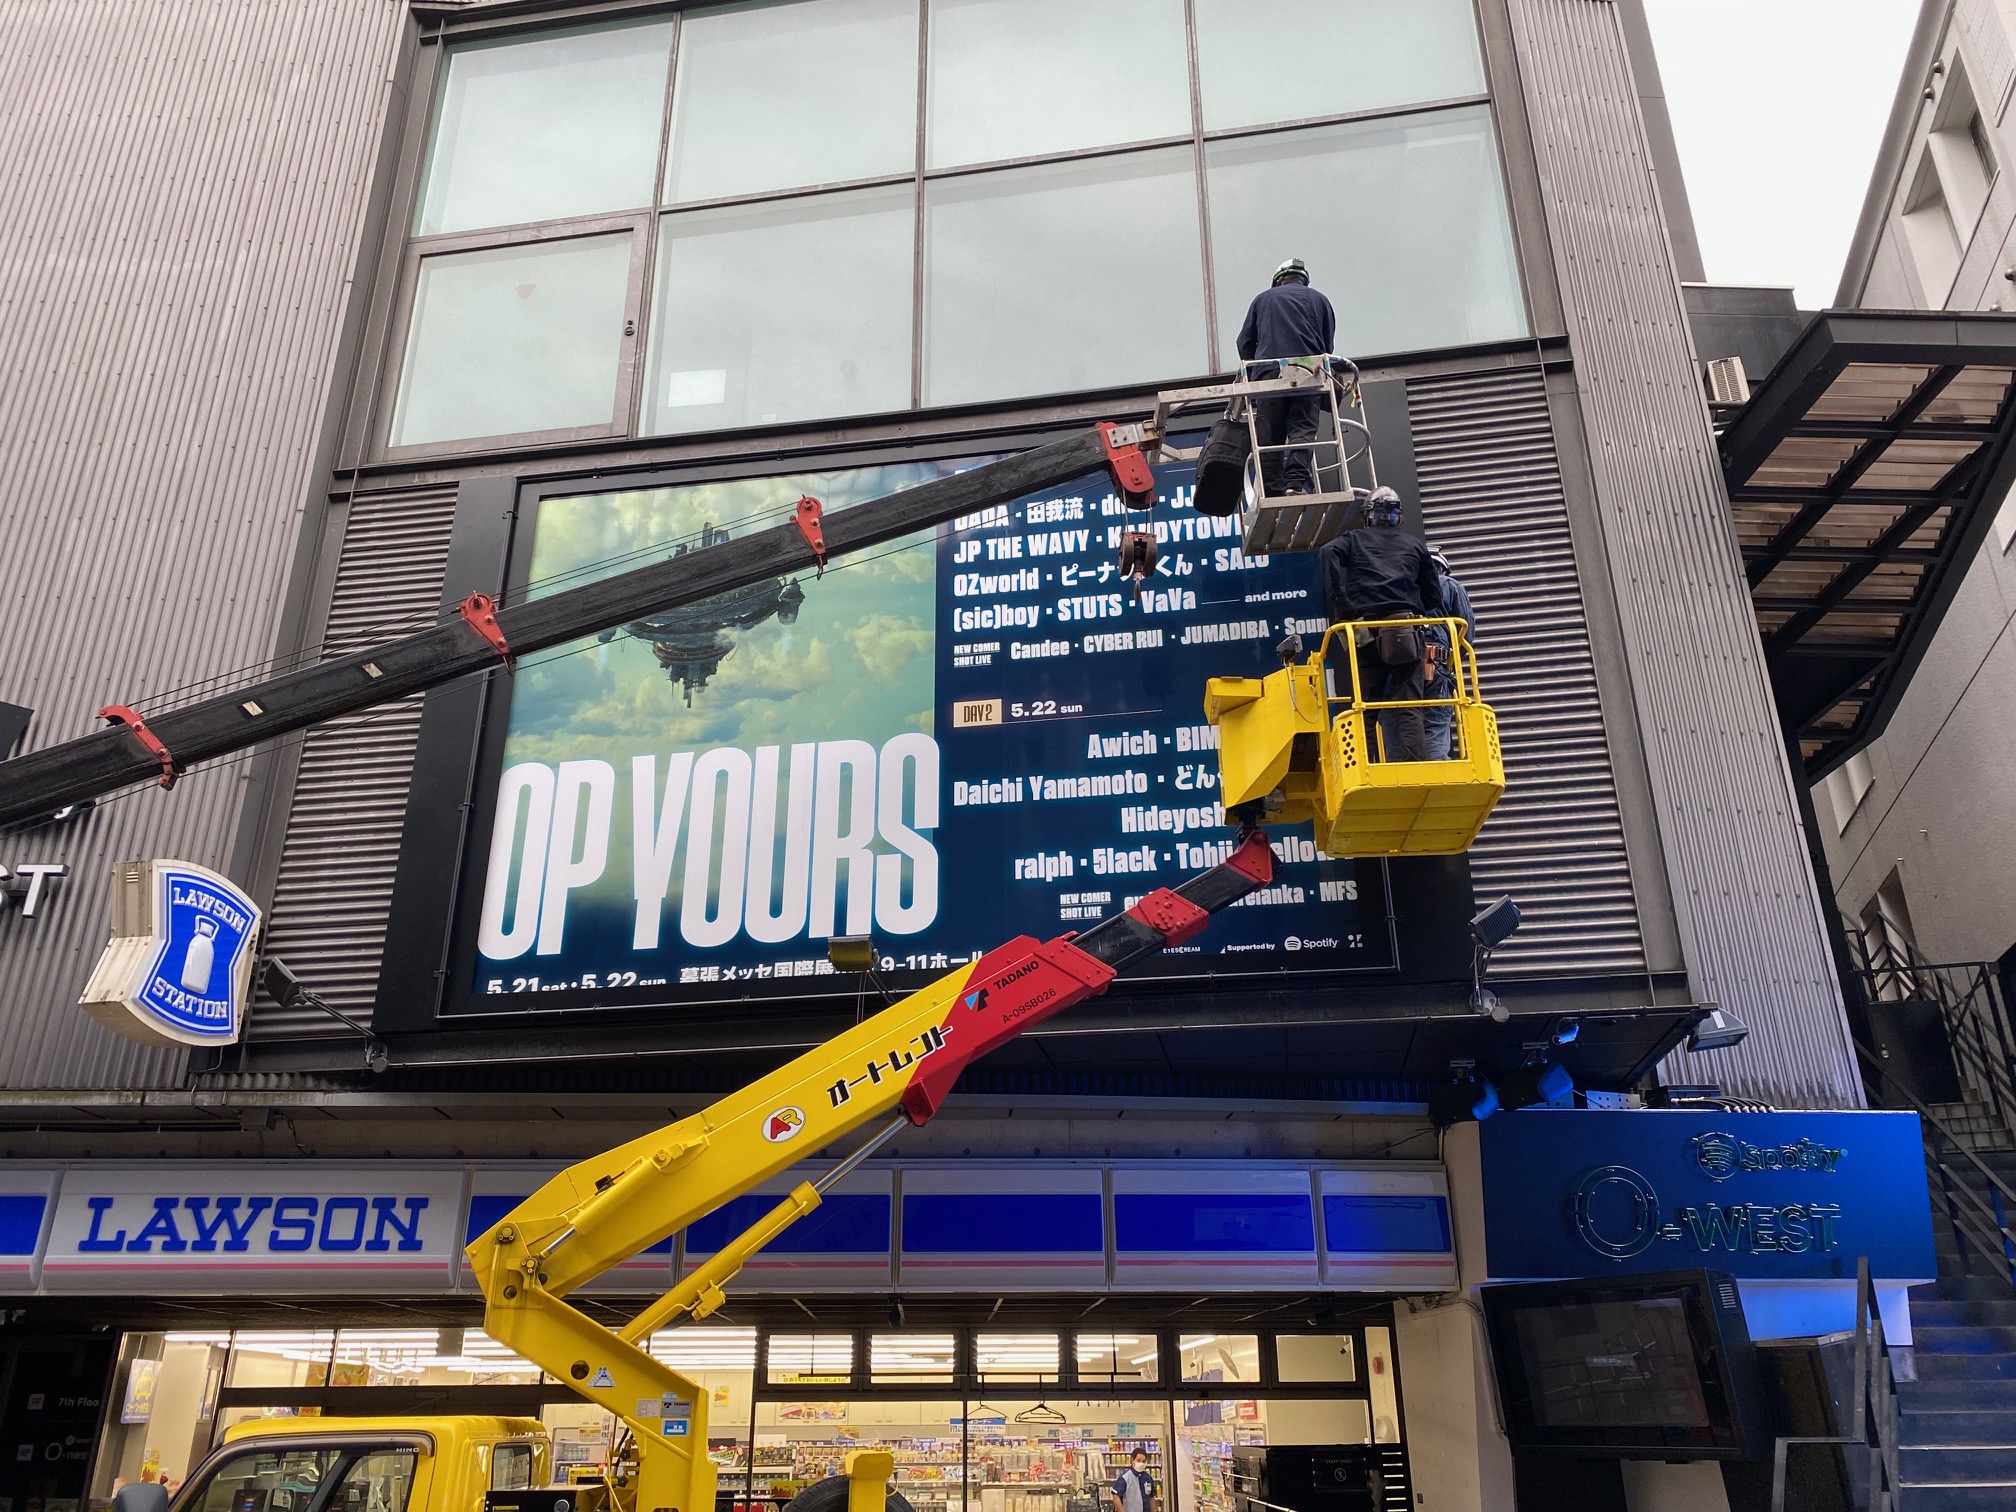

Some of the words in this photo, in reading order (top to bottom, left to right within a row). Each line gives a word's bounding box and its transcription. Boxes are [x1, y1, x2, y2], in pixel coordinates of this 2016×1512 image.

[1026, 496, 1084, 524] 田我流
[954, 540, 981, 564] JP
[986, 535, 1023, 561] THE
[1027, 528, 1090, 557] WAVY
[954, 567, 1040, 597] OZworld
[1061, 553, 1193, 586] ピーナくん
[1057, 593, 1123, 622] STUTS
[1140, 587, 1197, 614] VaVa
[1244, 590, 1270, 603] and
[1271, 588, 1308, 600] more
[953, 644, 971, 655] NEW
[972, 641, 1001, 653] COMER
[1010, 639, 1070, 660] Candee
[1083, 632, 1134, 654] CYBER
[1136, 629, 1163, 649] RUI
[1180, 619, 1270, 645] JUMADIBA
[1284, 616, 1330, 636] Soun
[953, 655, 975, 667] SHOT
[975, 654, 992, 665] LIVE
[1010, 700, 1057, 718] 5.22
[1060, 703, 1083, 714] sun
[1087, 729, 1158, 759] Awich
[1176, 724, 1221, 752] BIM
[953, 776, 1023, 807] Daichi
[1029, 769, 1148, 801] Yamamoto
[1174, 763, 1224, 791] どん
[1121, 801, 1226, 834] Hideyosh
[632, 732, 940, 951] YOURS
[1014, 850, 1074, 882] ralph
[1092, 845, 1158, 876] 5lack
[1060, 893, 1080, 905] NEW
[1080, 891, 1112, 904] COMER
[1319, 880, 1358, 902] MFS
[172, 886, 247, 935] LAWSON
[1060, 907, 1083, 919] SHOT
[1083, 906, 1102, 918] LIVE
[1227, 942, 1265, 952] Supported
[1265, 941, 1276, 951] by
[1303, 937, 1338, 951] Spotify
[993, 959, 1041, 992] TADANO
[151, 975, 229, 1020] STATION
[1001, 987, 1057, 1025] A-09SB026
[77, 1196, 430, 1252] LAWSON
[57, 1397, 75, 1407] 7th
[77, 1397, 99, 1407] Floo
